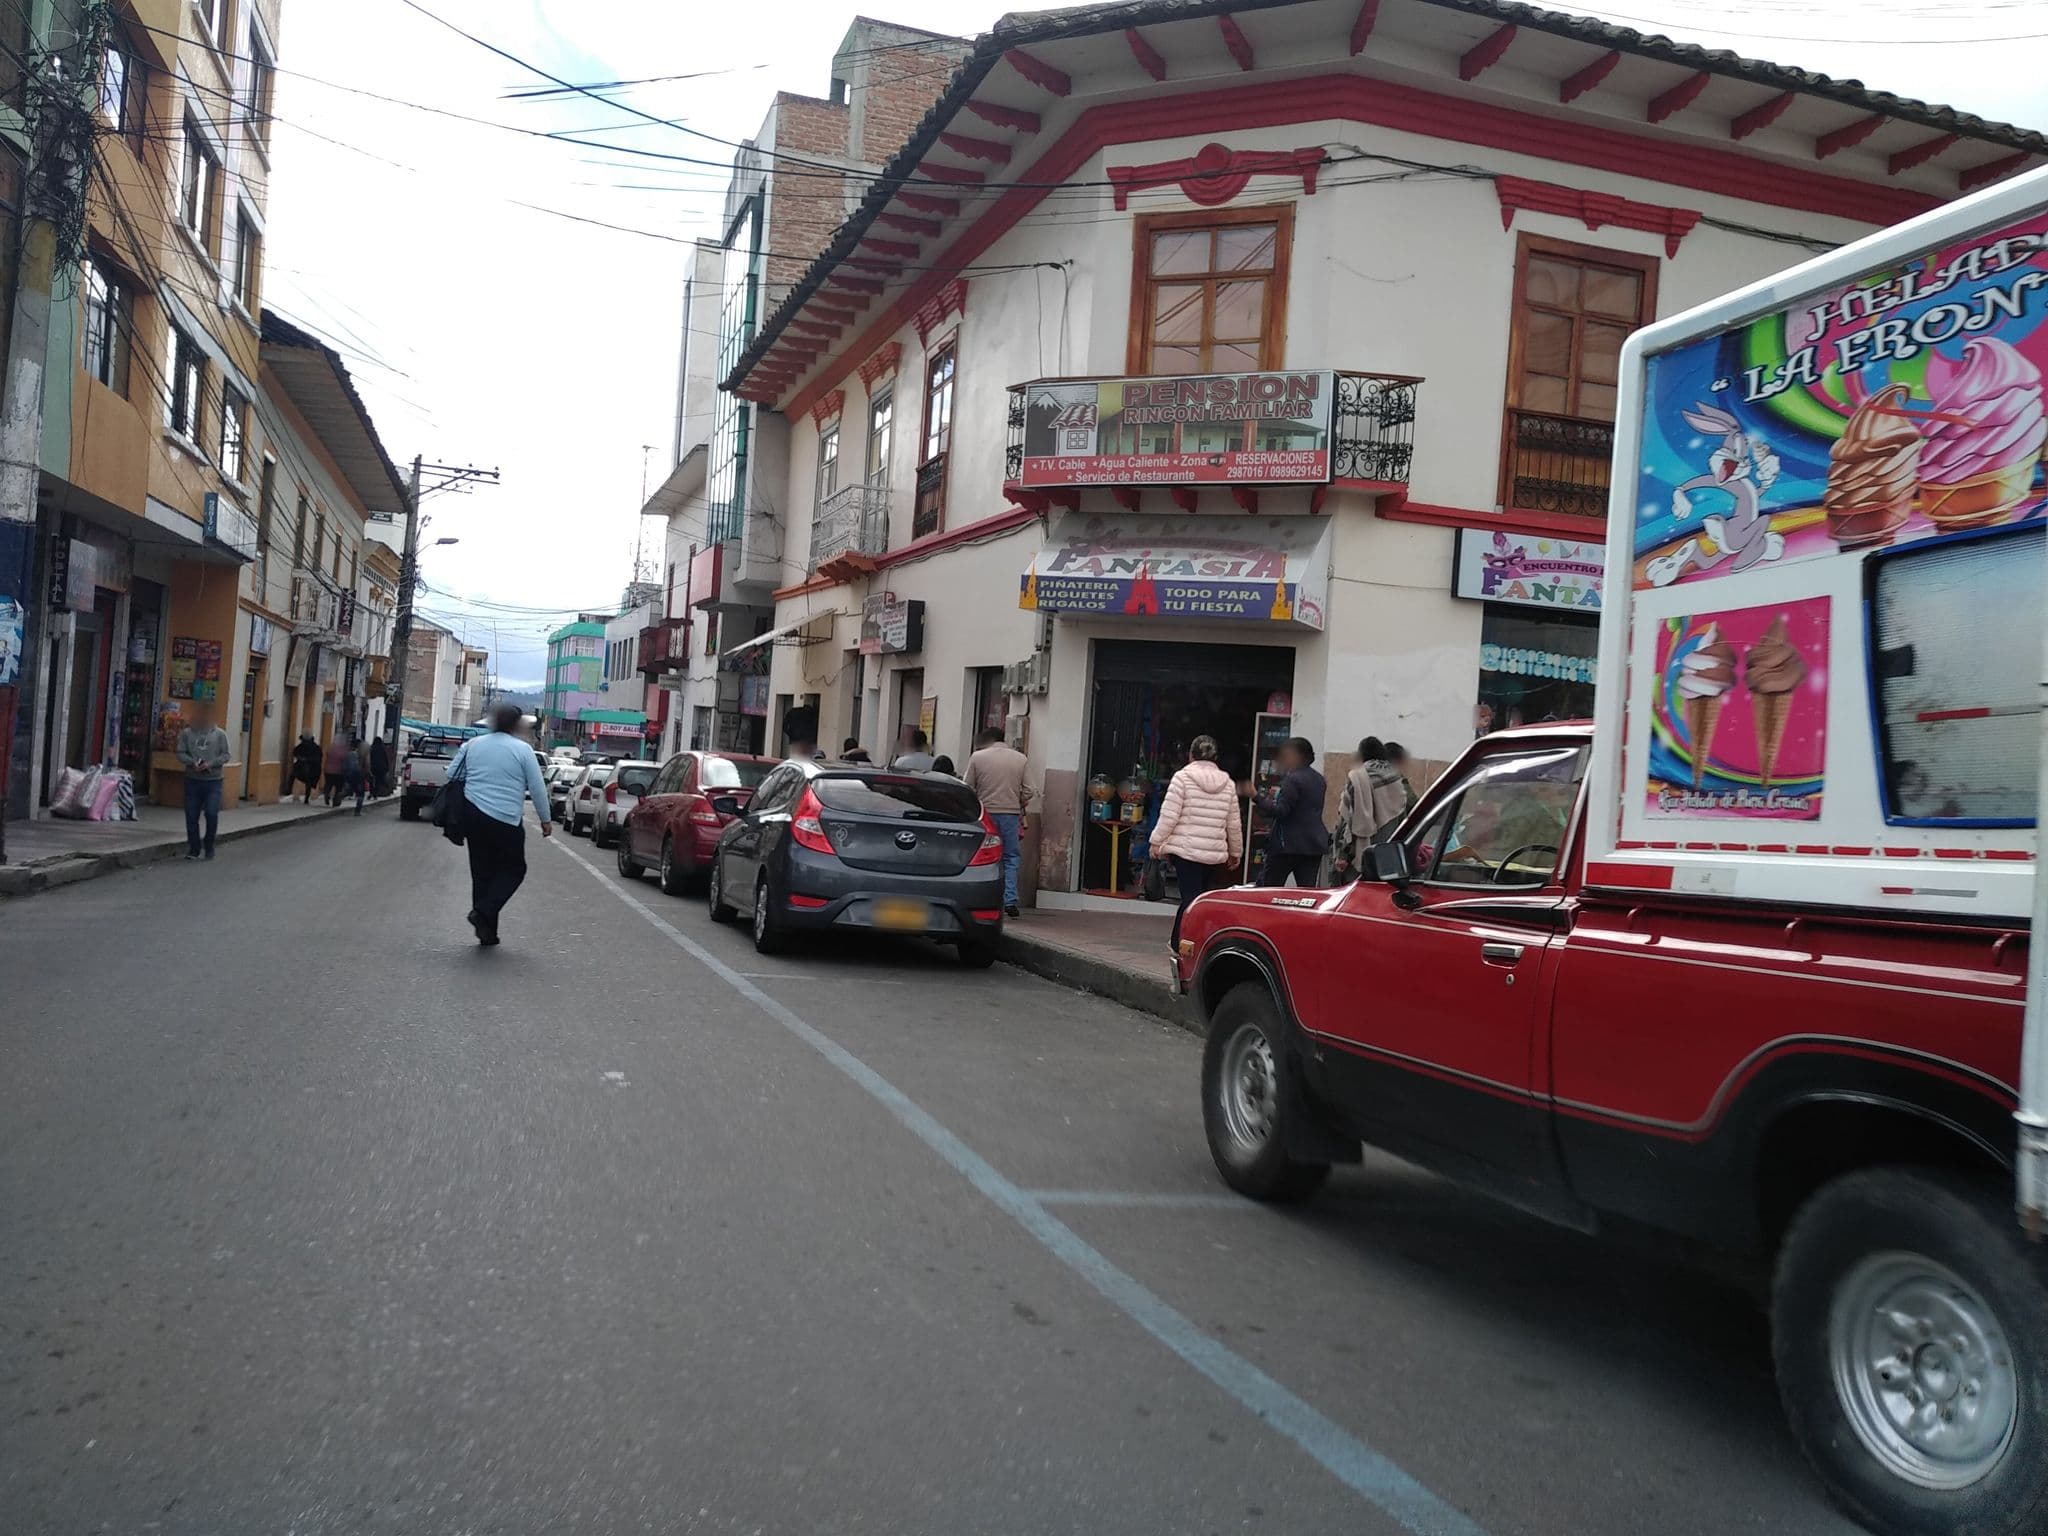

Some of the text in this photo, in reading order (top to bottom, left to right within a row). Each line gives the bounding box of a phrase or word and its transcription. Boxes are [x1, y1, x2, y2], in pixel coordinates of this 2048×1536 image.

[1806, 231, 2048, 340] HELAD
[1834, 271, 2048, 374] FRON
[1122, 374, 1319, 407] PENSION
[1123, 401, 1313, 424] RINCON FAMILIAR
[1040, 460, 1055, 471] T.V.
[1060, 459, 1086, 470] Cable
[1099, 457, 1125, 470] Agua
[1127, 456, 1169, 468] Caliente
[1180, 455, 1207, 467] Zona
[1235, 452, 1315, 465] RESERVACIONES
[1075, 470, 1195, 482] Servicio de Restaurante
[1227, 466, 1263, 478] 2987016
[1047, 547, 1286, 579] FANTASIA
[1523, 562, 1597, 573] ENCUENTRO
[1040, 579, 1120, 591] PIÑATERIA
[1039, 590, 1114, 600] JUGUETES
[1165, 587, 1261, 601] TODO PARA
[1038, 599, 1106, 610] REGALOS
[1164, 600, 1245, 613] TU FIESTA
